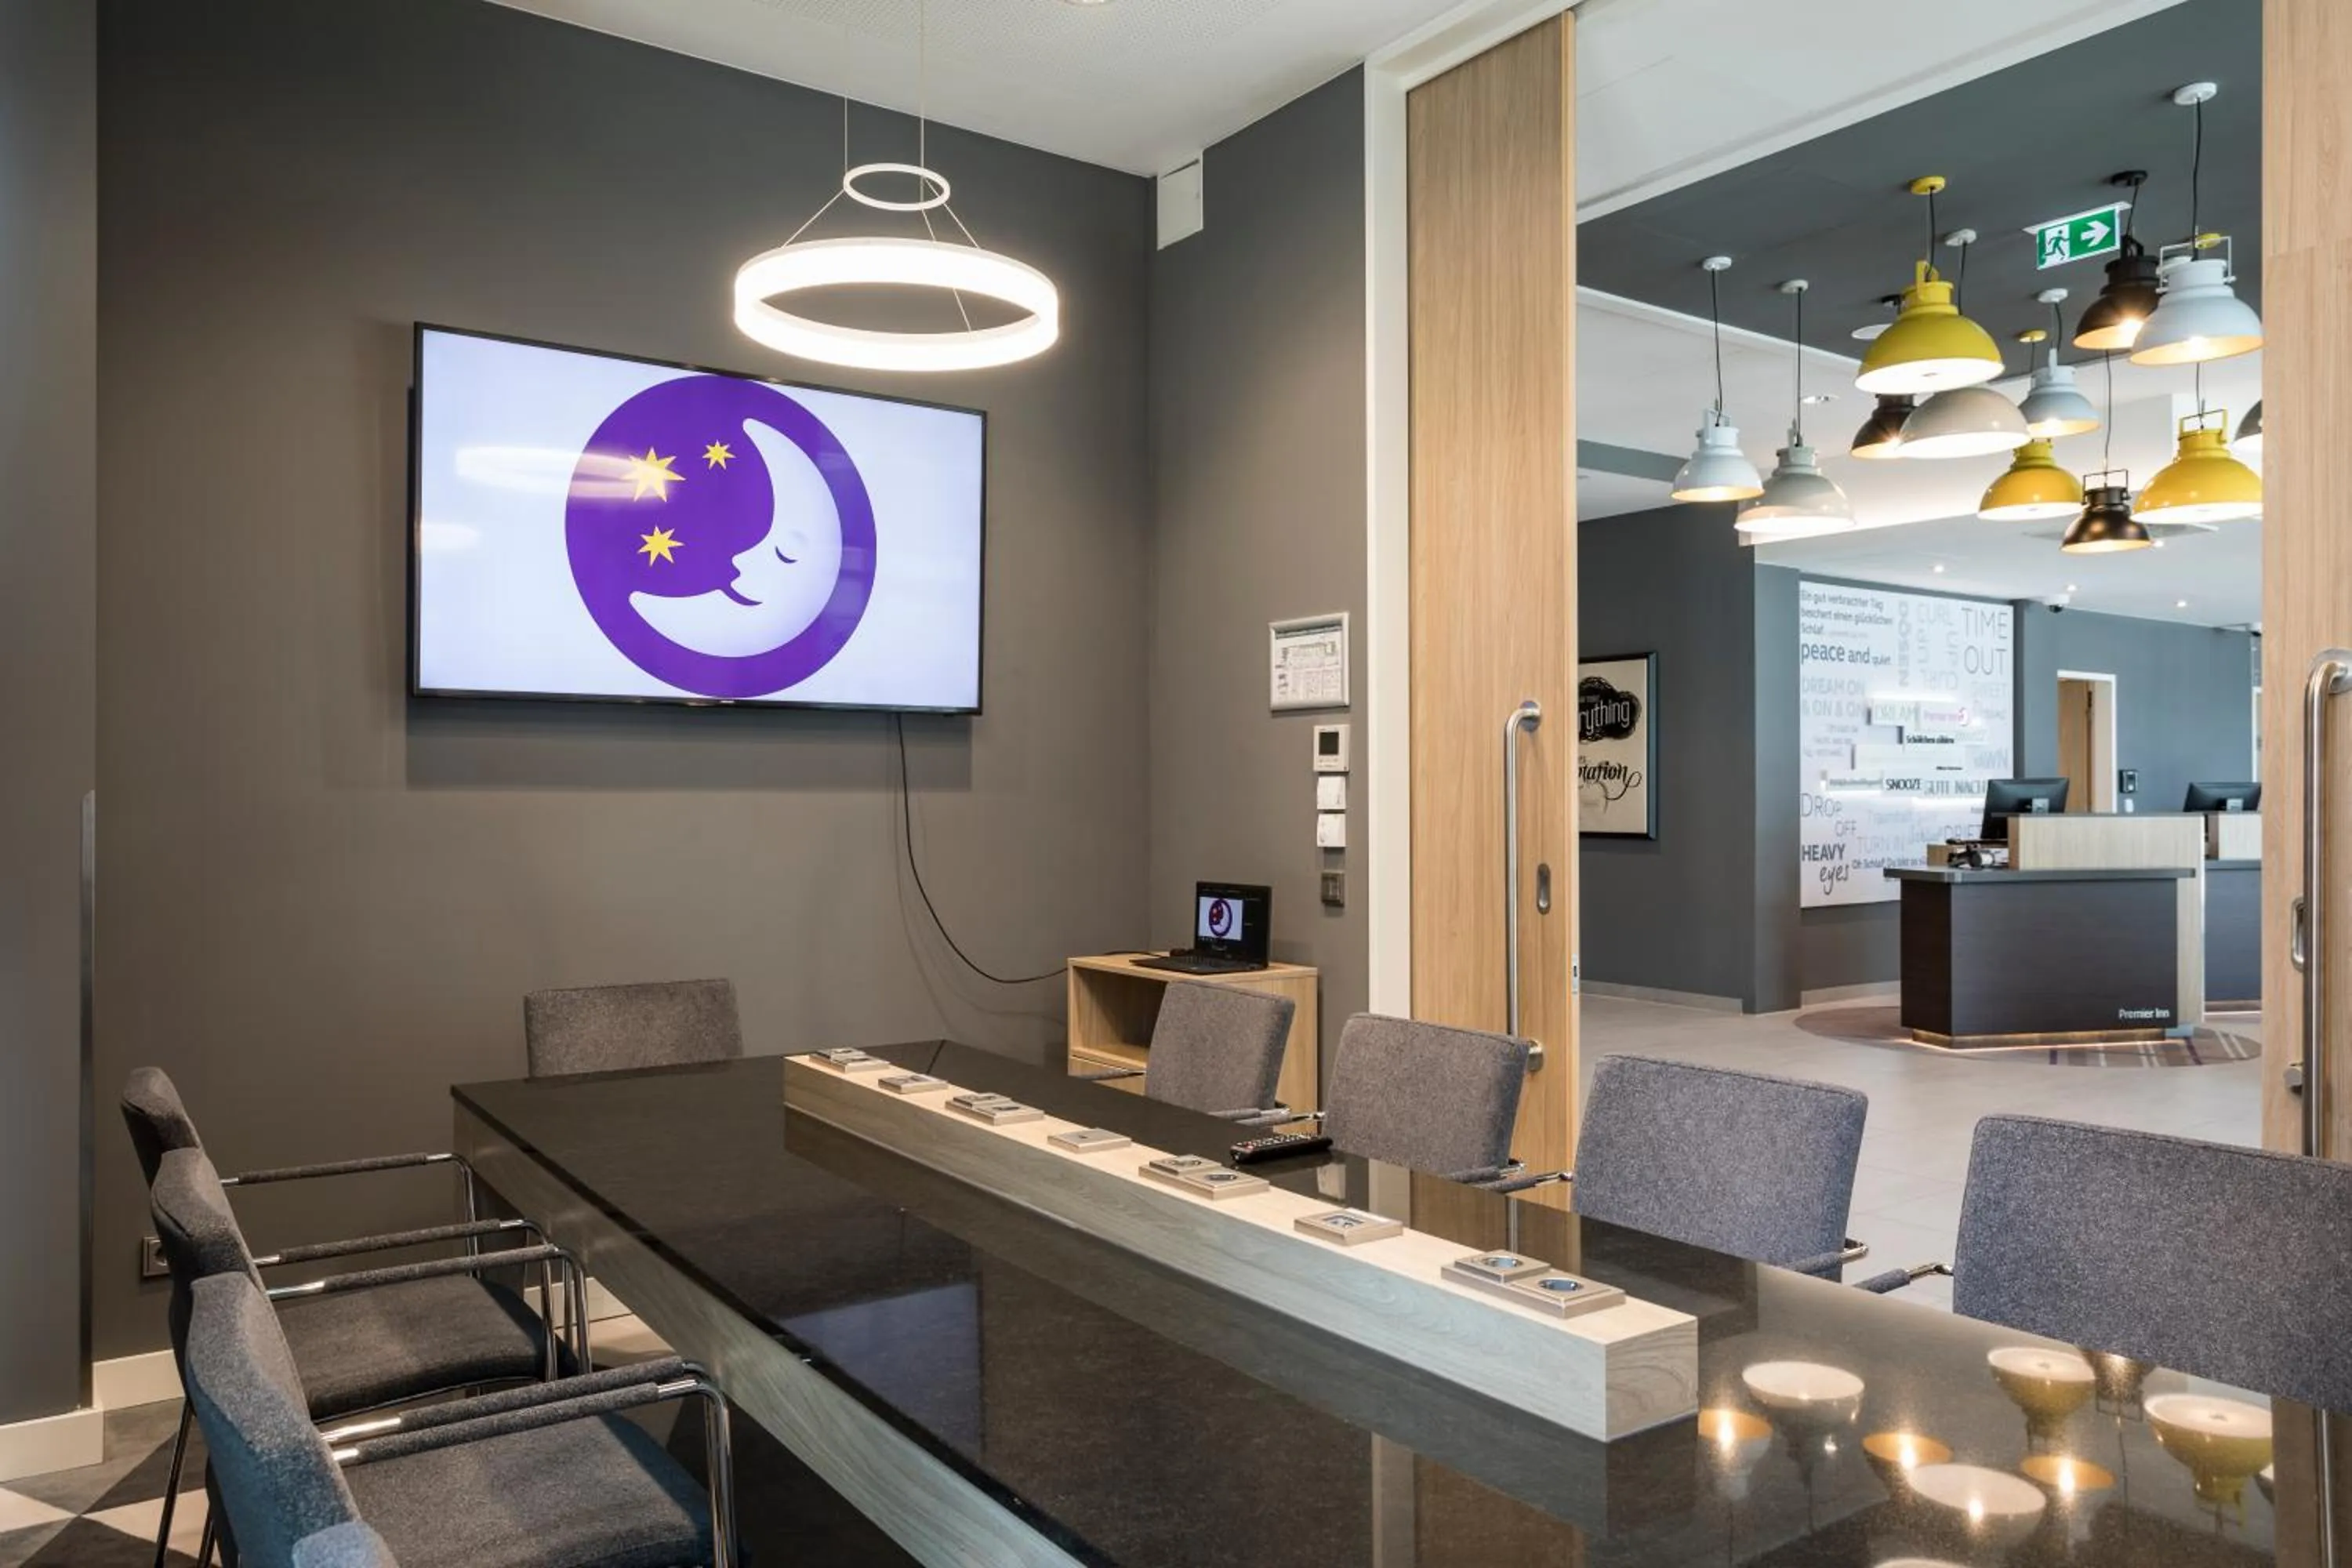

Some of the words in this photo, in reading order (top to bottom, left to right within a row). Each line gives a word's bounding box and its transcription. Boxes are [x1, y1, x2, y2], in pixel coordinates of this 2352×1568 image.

[1961, 607, 2008, 639] TIME
[1802, 642, 1845, 666] peace
[1848, 646, 1871, 664] and
[1964, 645, 2008, 676] OUT
[1885, 778, 1922, 791] SNOOZE
[1801, 792, 1842, 818] DROP
[1835, 819, 1857, 837] OFF
[1802, 842, 1846, 862] HEAVY
[1819, 863, 1849, 896] eyes
[2118, 1008, 2154, 1018] Premier
[2155, 1008, 2170, 1018] Inn
